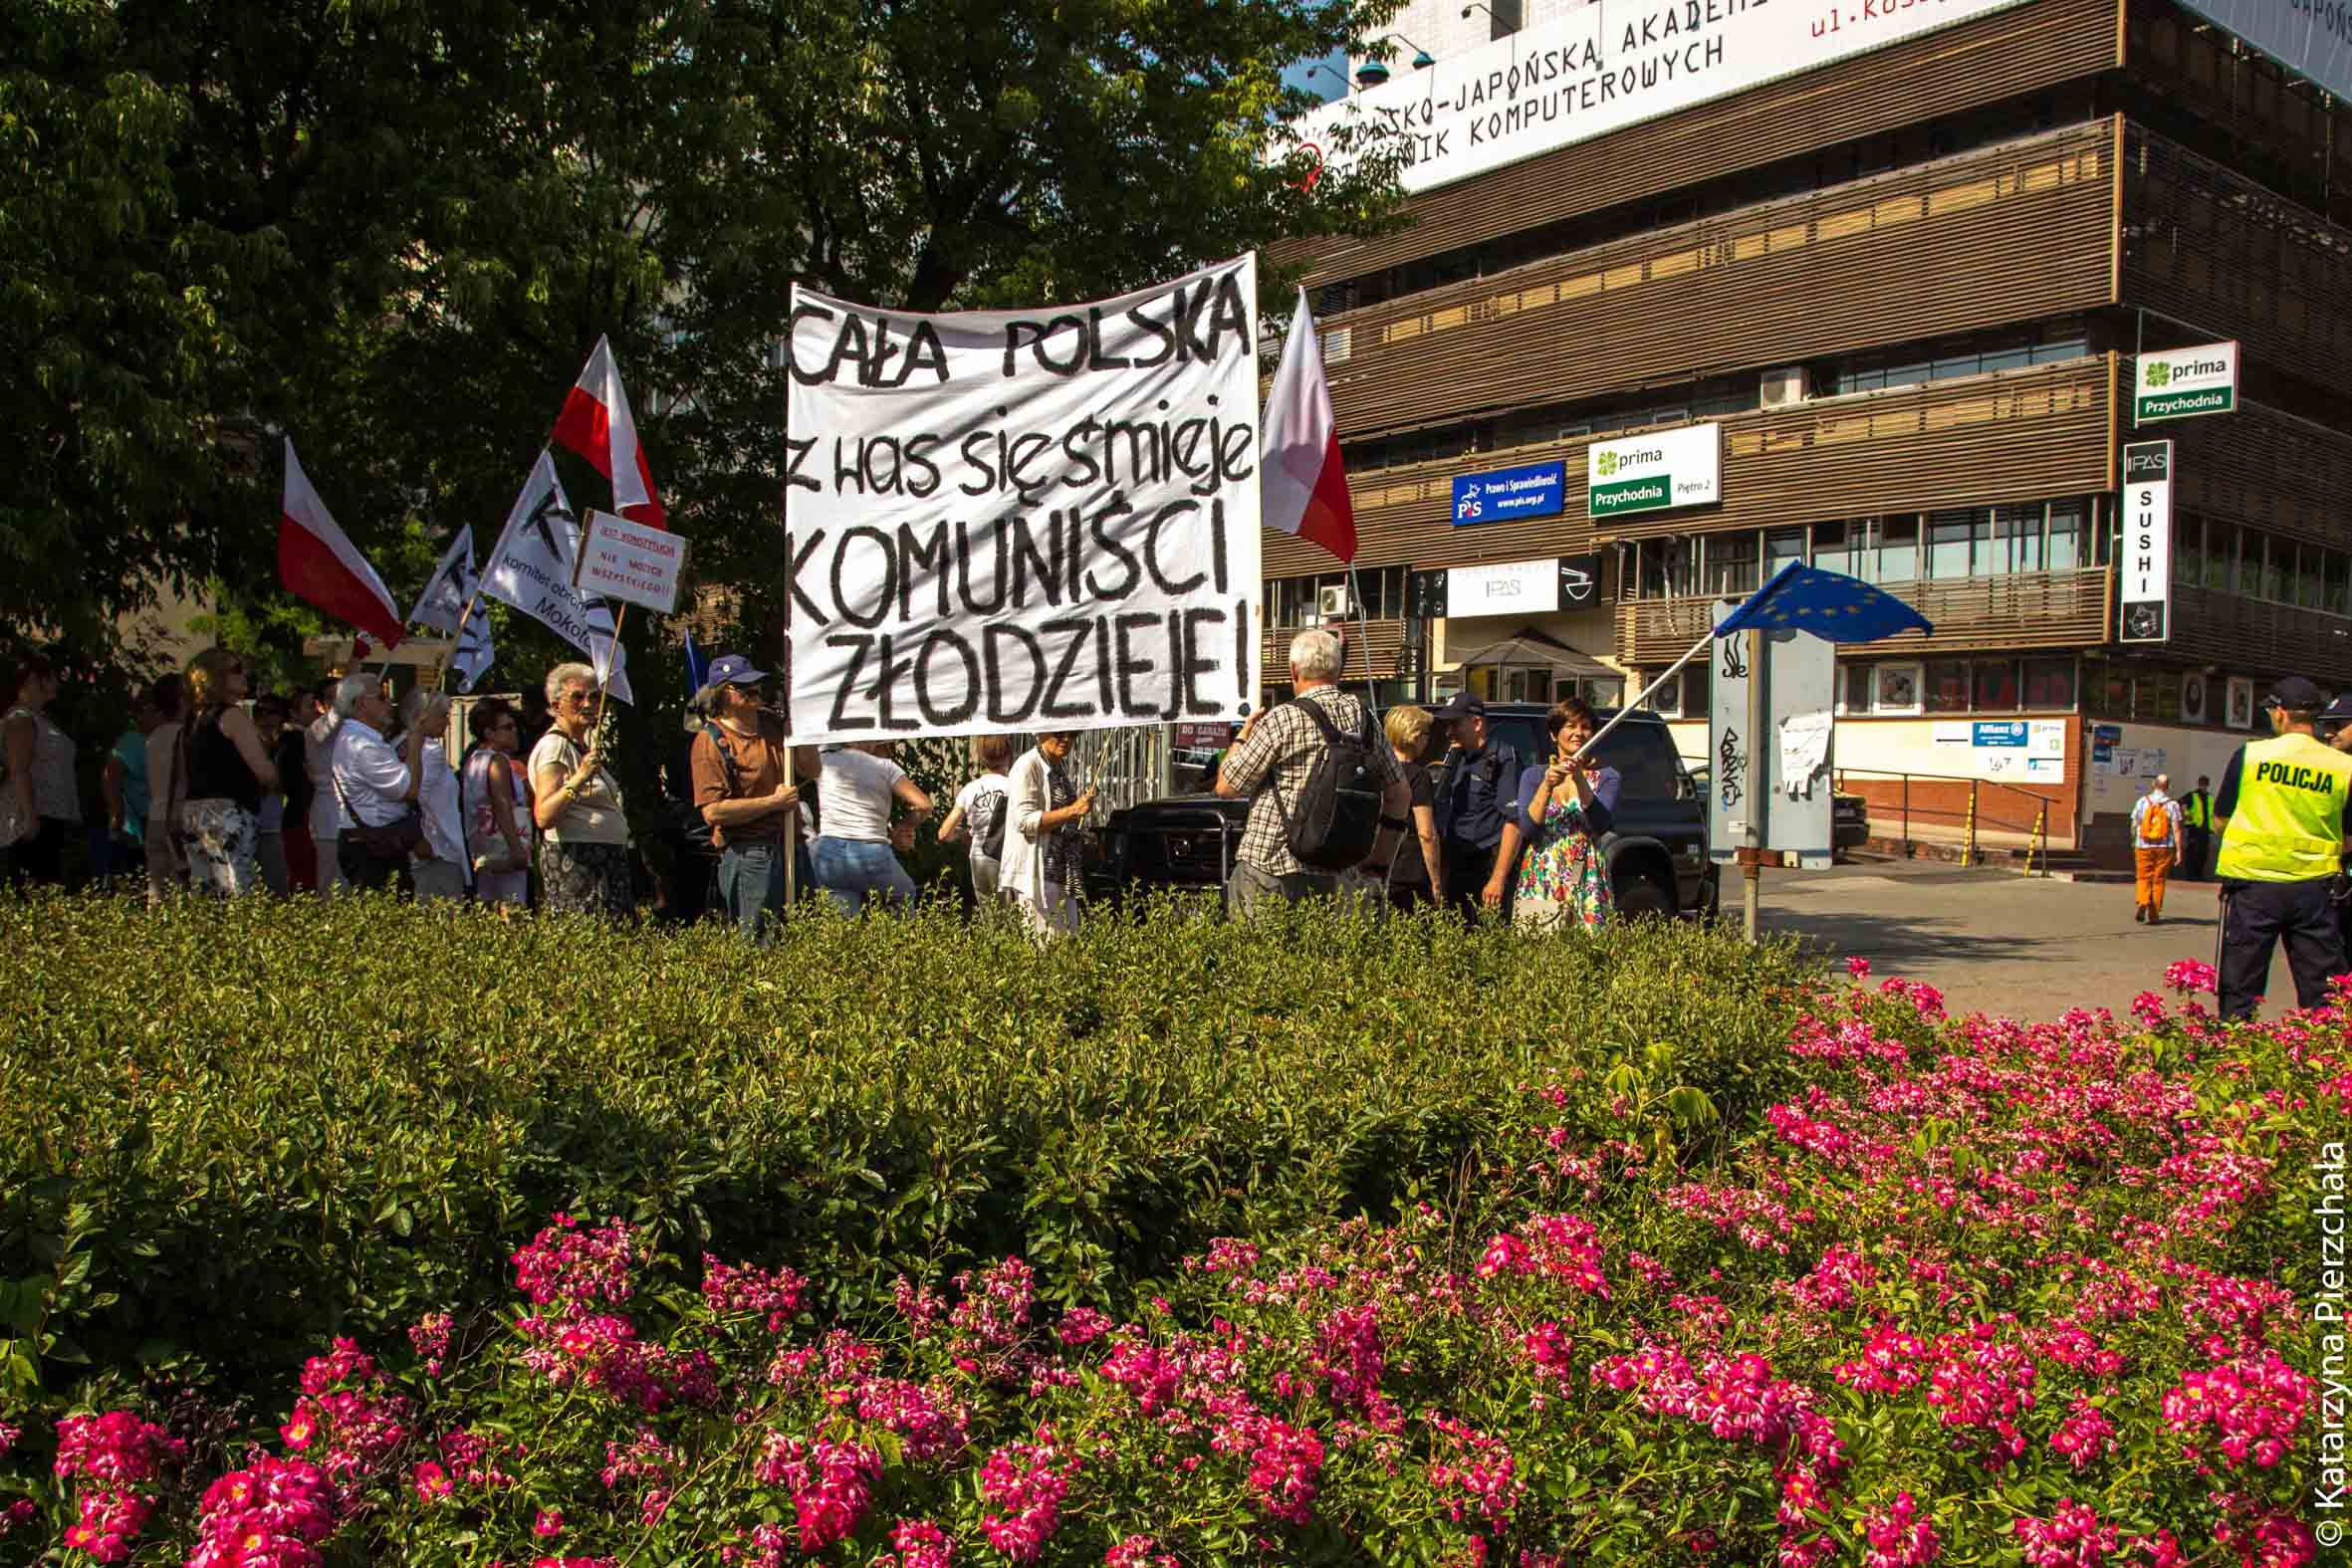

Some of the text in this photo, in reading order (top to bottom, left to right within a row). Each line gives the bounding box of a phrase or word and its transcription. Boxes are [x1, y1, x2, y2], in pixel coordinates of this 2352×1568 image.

[1470, 35, 1724, 146] KOMPUTEROWYCH
[790, 271, 1252, 388] CAŁA POLSKA
[2172, 359, 2227, 381] prima
[2145, 393, 2224, 414] Przychodnia
[958, 405, 1052, 507] się
[1060, 393, 1254, 497] śmieje
[1618, 449, 1664, 470] prima
[1486, 483, 1505, 495] Prawo
[1510, 472, 1557, 493] Sprawiedliwość
[1677, 478, 1711, 494] Piętro 2
[1497, 494, 1545, 508] www.pis.org.pl
[1595, 485, 1664, 507] Przychodnia
[2139, 490, 2153, 594] SUSHI
[599, 550, 617, 563] NIE
[785, 490, 1229, 632] KOMUNIŚCI
[502, 552, 551, 588] komitet
[825, 599, 1253, 733] ZŁODZIEJE!
[1181, 724, 1194, 735] DO
[1978, 724, 2010, 735] Allianz
[2256, 762, 2333, 795] POLICJA
